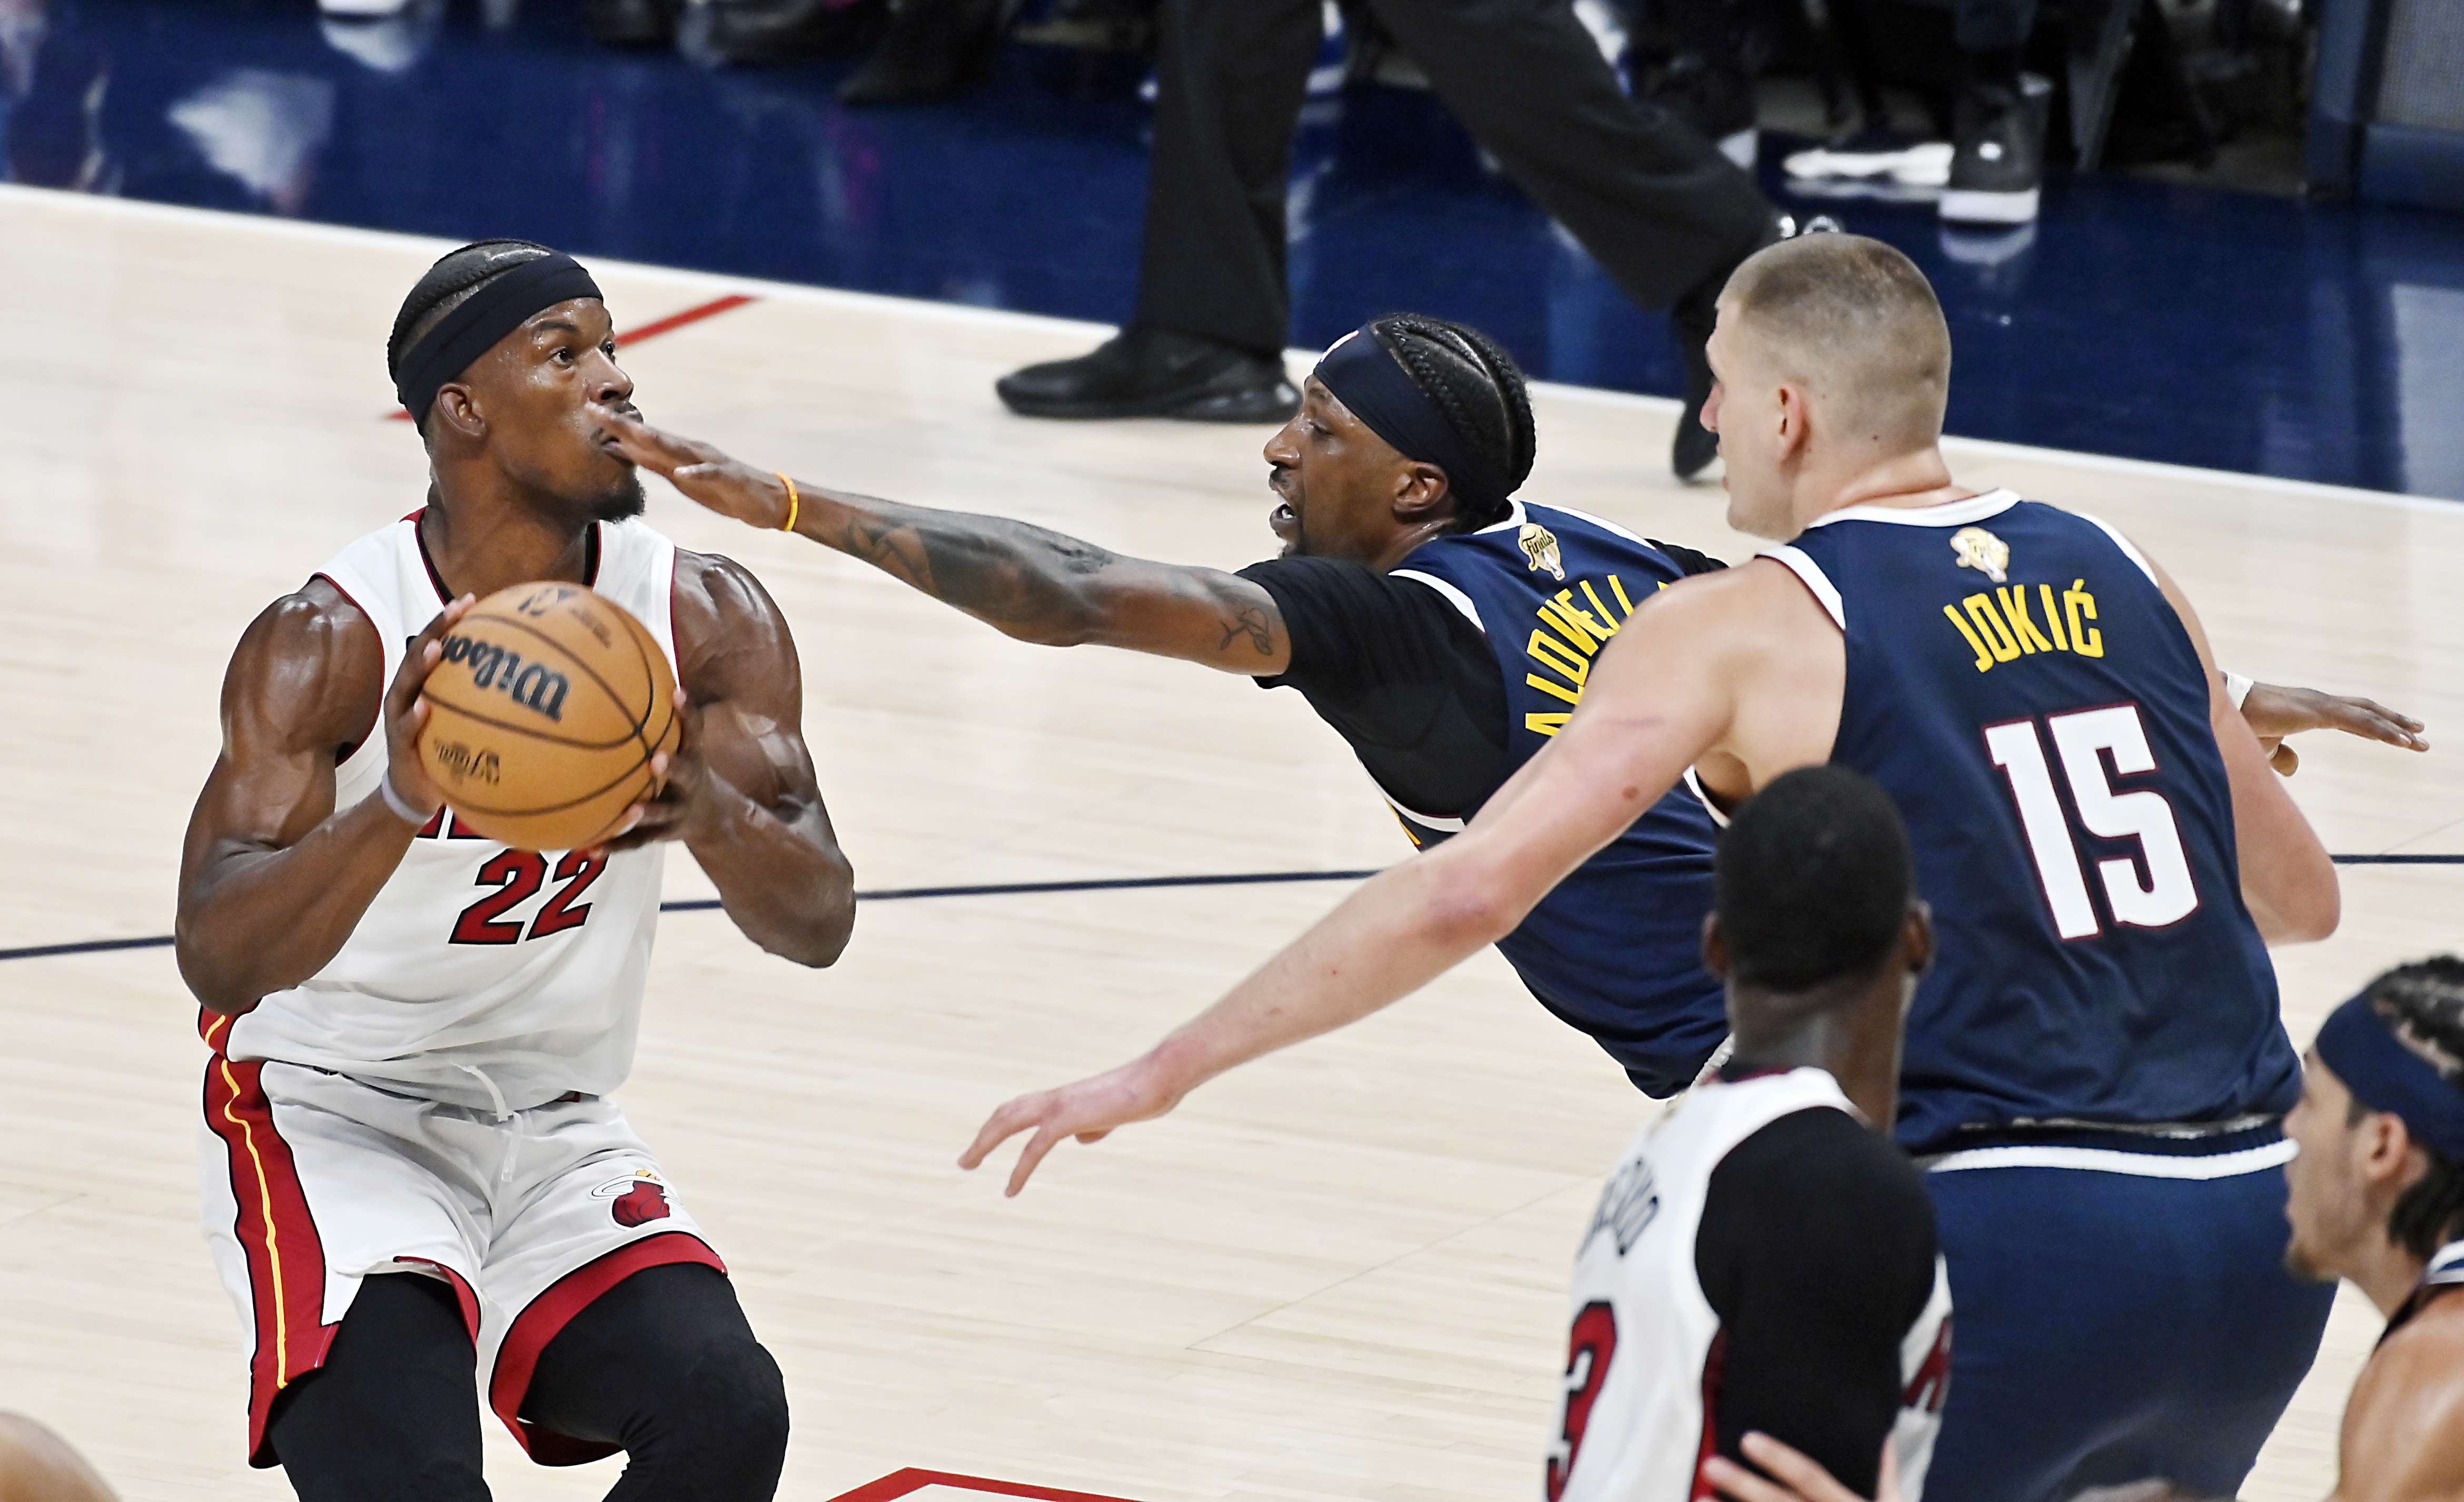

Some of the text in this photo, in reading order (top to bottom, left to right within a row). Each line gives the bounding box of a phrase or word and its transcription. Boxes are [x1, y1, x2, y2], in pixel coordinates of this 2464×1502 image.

[1521, 529, 1555, 568] Finals
[1943, 578, 2104, 673] JOKIĆ
[1984, 702, 2200, 940] 15
[448, 848, 610, 945] 22
